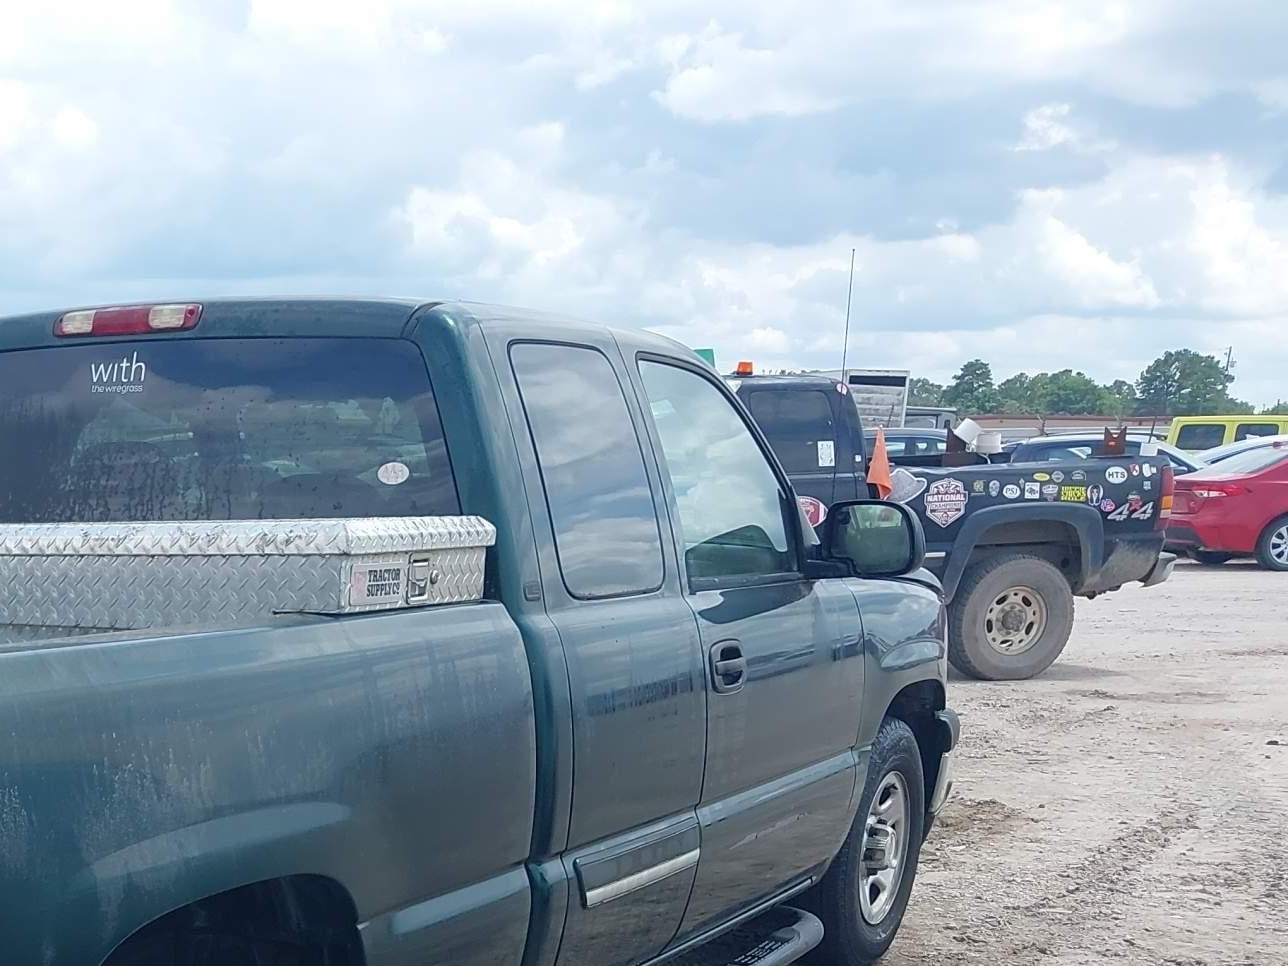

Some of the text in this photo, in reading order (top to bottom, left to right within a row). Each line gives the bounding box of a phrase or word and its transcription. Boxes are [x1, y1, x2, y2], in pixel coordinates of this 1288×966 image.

[91, 351, 146, 383] with
[91, 384, 144, 395] the wiregrass
[1107, 471, 1126, 480] HTS
[926, 493, 966, 502] NATIONAL
[368, 568, 401, 583] TRACTOR
[366, 582, 392, 597] SUPPLY
